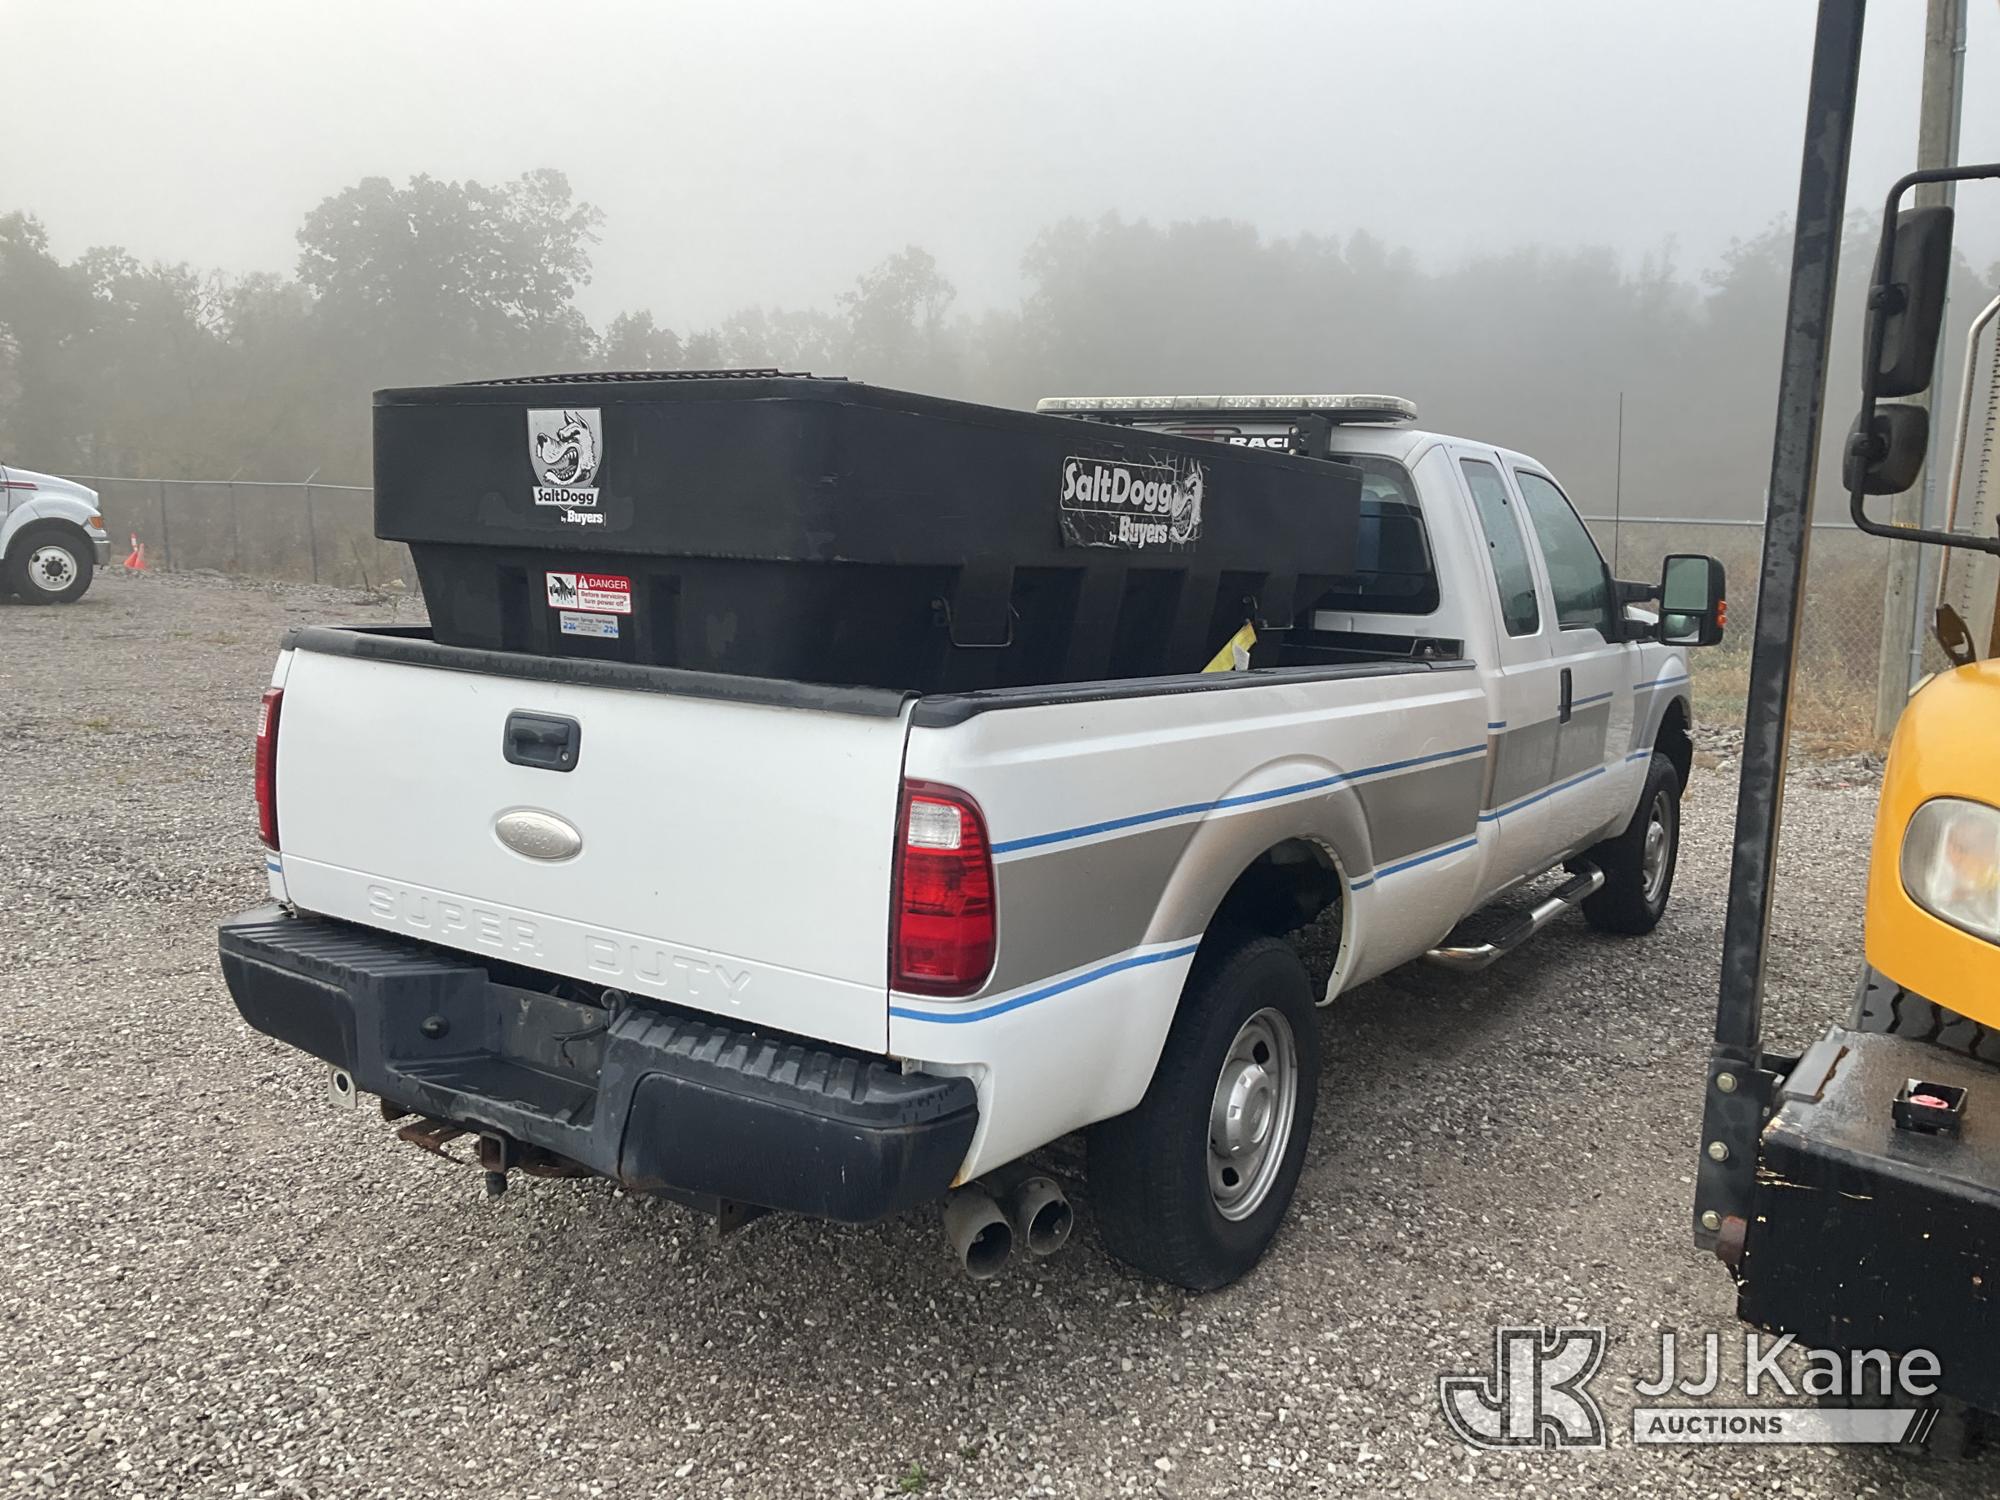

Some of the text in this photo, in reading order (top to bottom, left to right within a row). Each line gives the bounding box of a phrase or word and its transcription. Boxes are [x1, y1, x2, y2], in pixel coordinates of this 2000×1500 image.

[538, 488, 594, 504] SaltDogg
[1063, 463, 1173, 513] SaltDogg
[567, 509, 603, 525] Buyers
[1118, 516, 1169, 549] Buyers
[589, 578, 628, 589] DANGER
[600, 592, 627, 601] servicing
[367, 884, 752, 1004] SUPER DUTY
